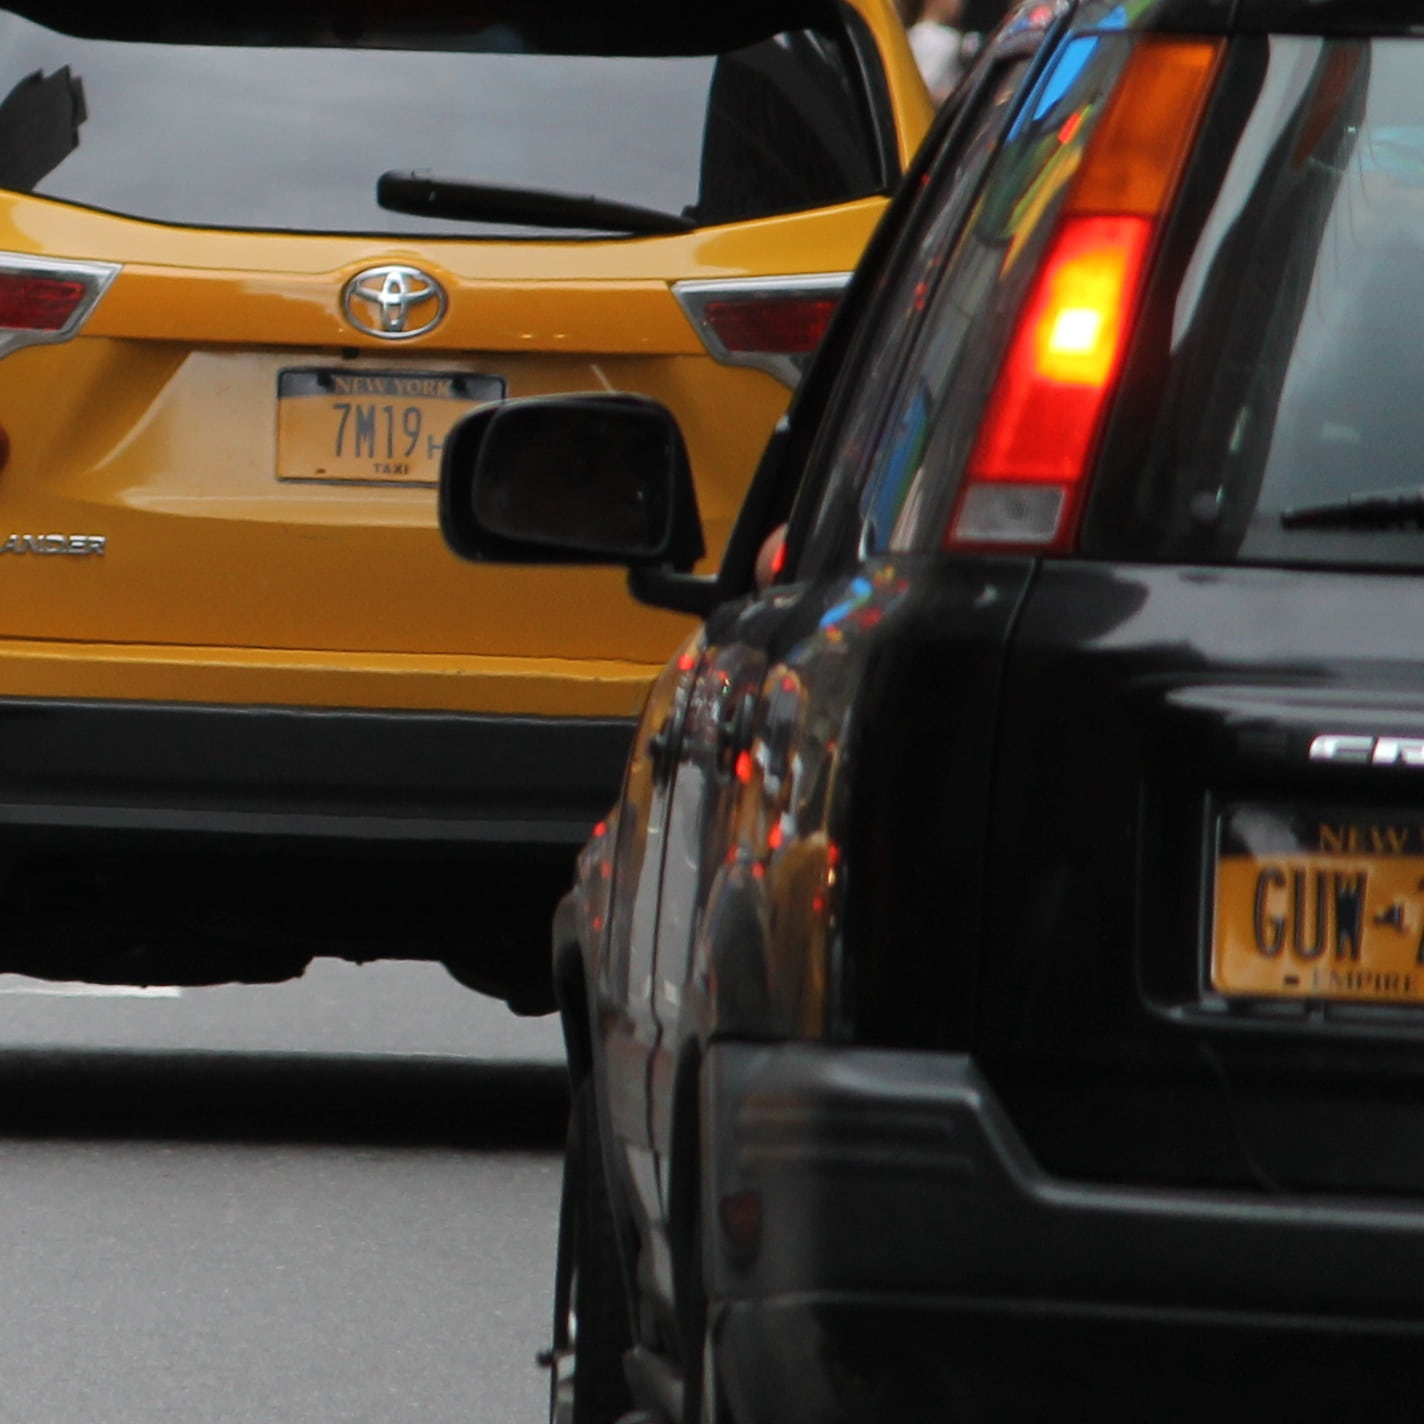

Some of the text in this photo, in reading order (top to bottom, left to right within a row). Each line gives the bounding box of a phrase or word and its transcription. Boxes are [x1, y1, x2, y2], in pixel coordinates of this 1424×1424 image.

[333, 376, 454, 398] NEW YORK
[373, 463, 410, 475] TAXI
[1318, 824, 1409, 854] NEW
[1255, 865, 1368, 963] GUW
